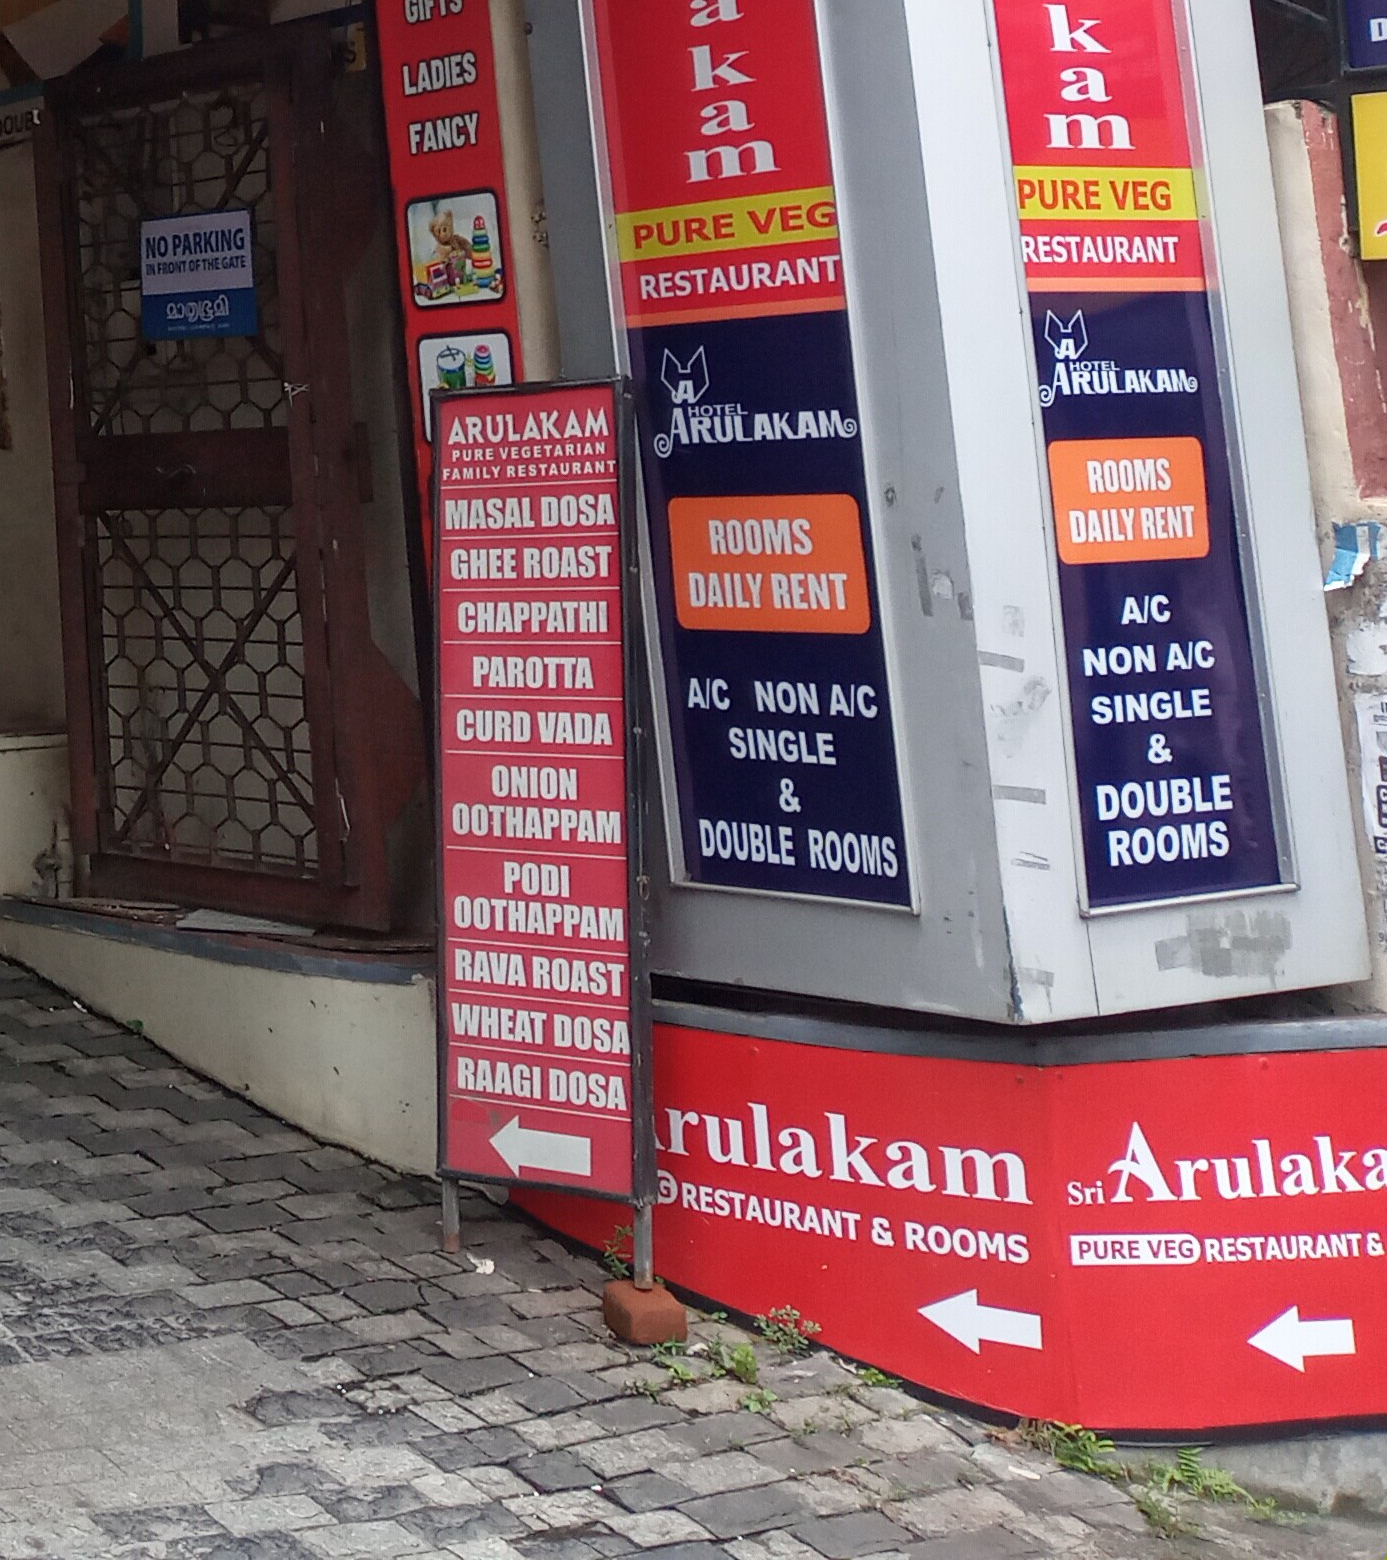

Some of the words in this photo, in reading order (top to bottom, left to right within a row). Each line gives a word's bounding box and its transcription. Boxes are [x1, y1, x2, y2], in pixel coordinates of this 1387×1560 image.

[402, 52, 477, 96] LADIES
[409, 114, 478, 155] FANCY
[1018, 179, 1101, 211] PURE
[1113, 179, 1173, 211] VEG
[145, 236, 169, 260] NO
[172, 227, 245, 256] PARKING
[632, 216, 734, 251] PURE
[747, 200, 837, 235] VEG
[145, 263, 156, 276] IN
[157, 261, 187, 275] FRONT
[188, 260, 201, 272] OF
[202, 258, 221, 271] THE
[222, 255, 246, 269] GATE
[1023, 234, 1179, 265] RESTAURANT
[640, 254, 840, 301] RESTAURANT
[1069, 359, 1120, 372] HOTEL
[1039, 363, 1198, 408] ARULAKAM
[447, 406, 609, 445] ARULAKAM
[688, 403, 748, 417] HOTEL
[452, 446, 494, 462] PURE
[499, 441, 606, 460] VEGETARIAN
[653, 407, 857, 458] ARULAKAM
[442, 464, 501, 481] FAMILY
[506, 460, 617, 478] RESTAURANT
[1087, 458, 1171, 493] ROOMS
[445, 497, 535, 531] MASAL
[540, 493, 615, 528] DOSA
[1069, 507, 1134, 544] DAILY
[1140, 505, 1195, 541] RENT
[708, 517, 814, 555] ROOMS
[450, 547, 517, 580] GHEE
[523, 545, 613, 579] ROAST
[688, 572, 763, 609] DAILY
[771, 572, 848, 610] RENT
[1120, 594, 1171, 626] A/C
[457, 600, 609, 634] CHAPPATHI
[472, 655, 594, 690] PAROTTA
[1082, 645, 1156, 678] NON
[1166, 640, 1216, 673] A/C
[687, 677, 730, 711] A/C
[754, 680, 820, 714] NON
[829, 682, 878, 719] A/C
[1091, 689, 1213, 726] SINGLE
[456, 709, 531, 744] CURD
[537, 710, 613, 746] VADA
[728, 727, 836, 766] SINGLE
[1147, 733, 1173, 765] &
[491, 764, 577, 801] ONION
[779, 779, 801, 813] &
[1096, 774, 1234, 822] DOUBLE
[452, 802, 622, 844] OOTHAPPAM
[699, 817, 796, 868] DOUBLE
[808, 828, 898, 878] ROOMS
[1107, 822, 1230, 867] ROOMS
[503, 860, 570, 898] PODI
[453, 894, 625, 941] OOTHAPPAM
[454, 948, 526, 989] RAVA
[531, 954, 625, 998] ROAST
[451, 1001, 547, 1046] WHEAT
[553, 1012, 631, 1055] DOSA
[457, 1056, 544, 1099] RAAGI
[548, 1067, 627, 1112] DOSA
[1067, 1180, 1106, 1206] Sri
[681, 1181, 861, 1241] RESTAURANT
[871, 1216, 895, 1247] &
[905, 1221, 1031, 1265] ROOMS
[1078, 1239, 1141, 1262] PURE
[1147, 1239, 1196, 1262] VEG
[1205, 1234, 1355, 1264] RESTAURANT
[1366, 1232, 1385, 1257] &
